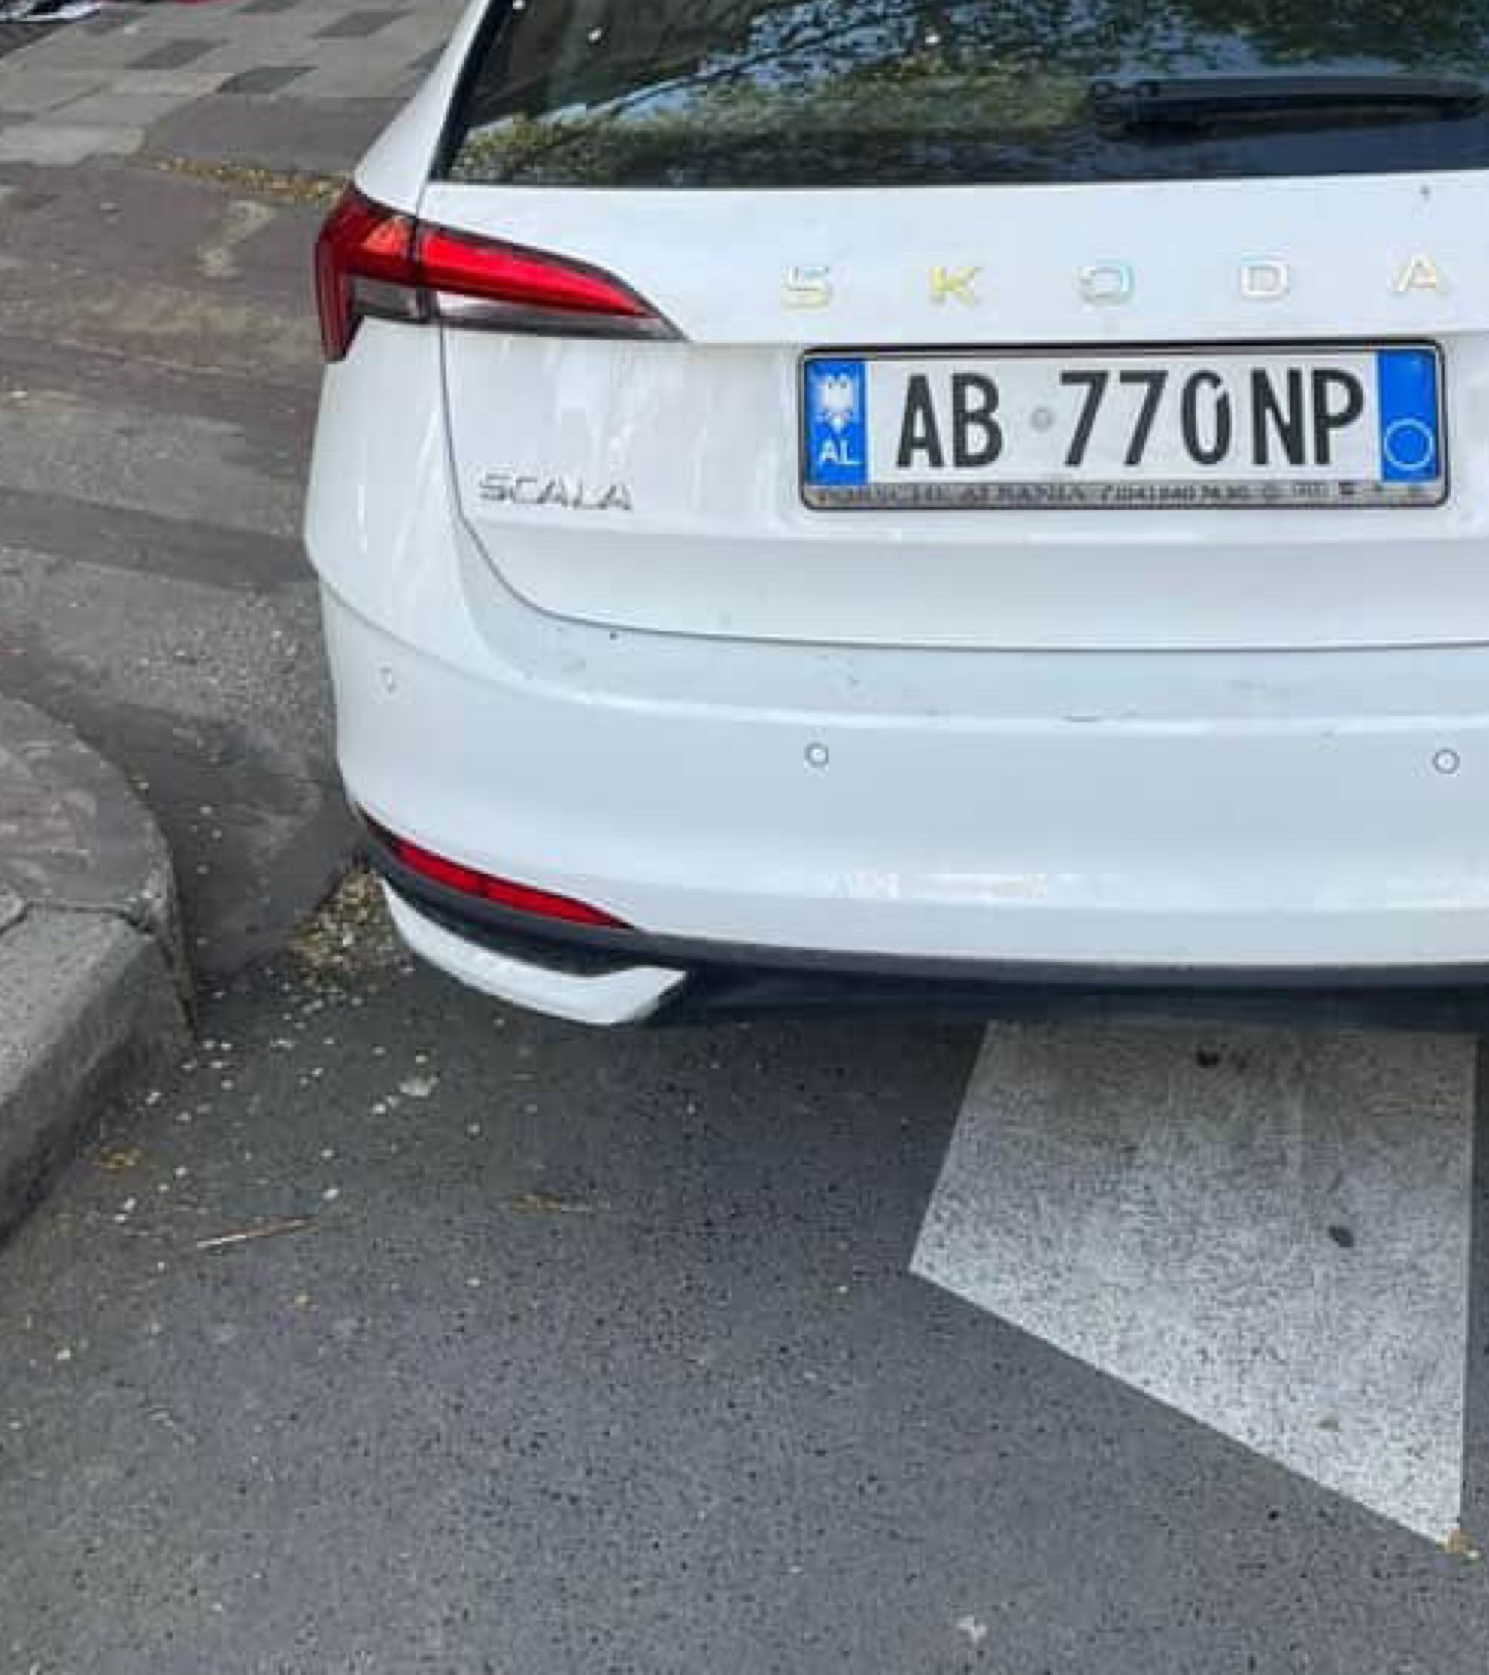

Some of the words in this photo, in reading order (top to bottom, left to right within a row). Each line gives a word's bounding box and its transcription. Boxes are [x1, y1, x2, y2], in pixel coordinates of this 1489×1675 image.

[780, 252, 1447, 310] SKODA
[895, 371, 1005, 469] AB
[819, 438, 862, 466] AL
[478, 472, 634, 512] SCALA
